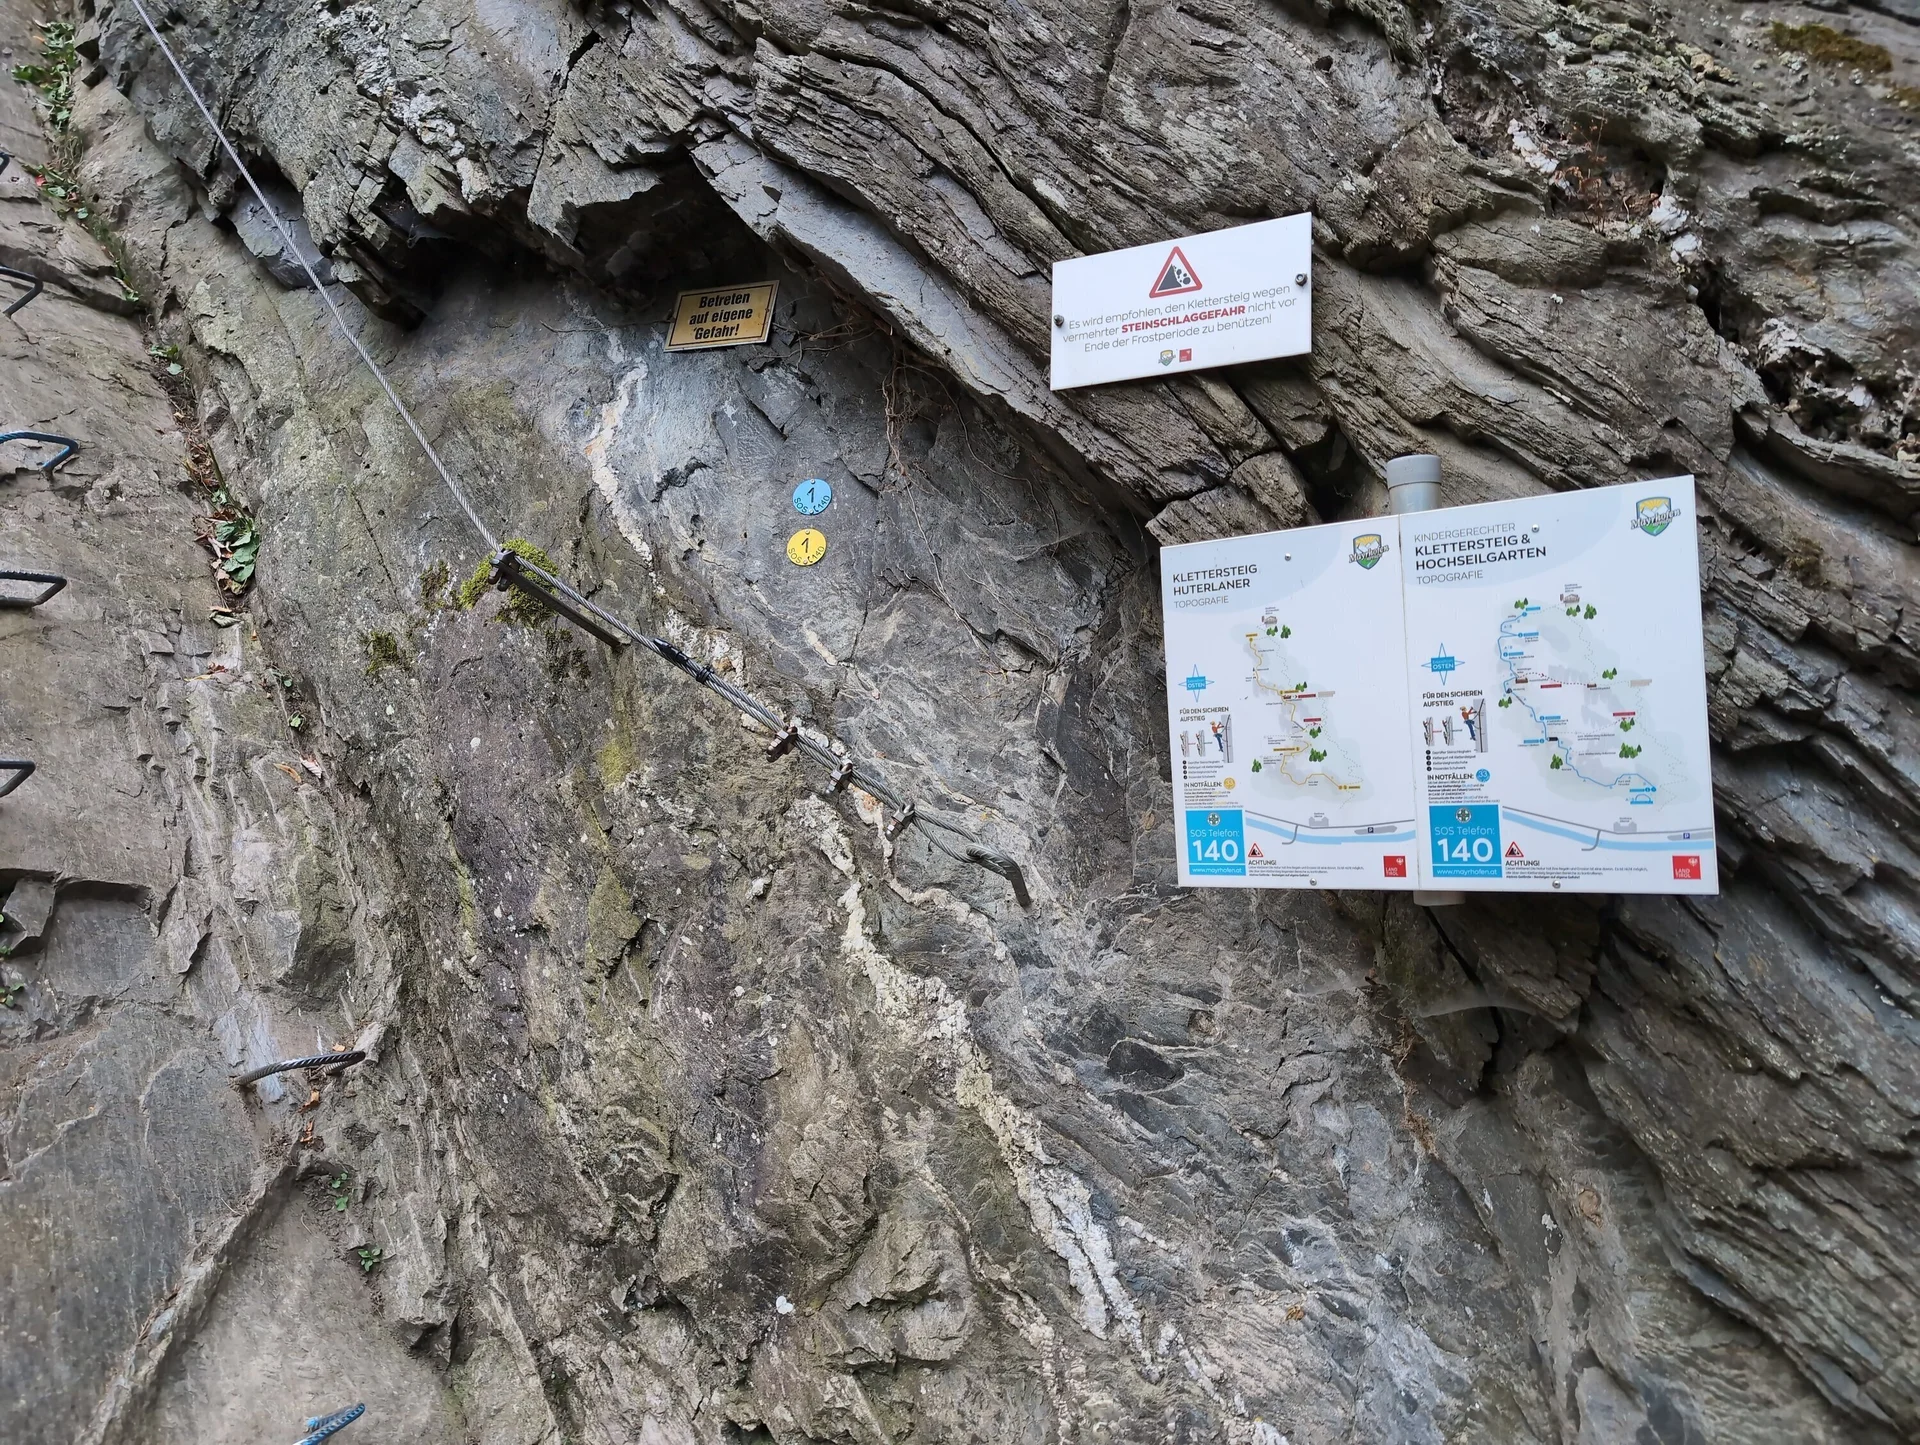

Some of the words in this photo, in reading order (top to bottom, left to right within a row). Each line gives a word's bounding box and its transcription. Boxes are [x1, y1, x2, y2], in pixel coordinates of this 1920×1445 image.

[699, 293, 750, 308] Betreten
[1069, 320, 1080, 329] Es
[1083, 316, 1103, 327] wird
[1105, 307, 1162, 324] empfohlen,
[1165, 302, 1185, 313] den
[1188, 291, 1250, 309] Klettersteig
[1253, 285, 1290, 298] wegen
[689, 315, 709, 325] auf
[712, 308, 753, 322] eigene
[1063, 326, 1119, 343] vermehrter
[1121, 305, 1246, 333] STEINSCHLAGGEFAHR
[1248, 301, 1276, 313] nicht
[1276, 298, 1297, 308] vor
[694, 324, 740, 340] Gefahr!
[1085, 342, 1110, 352] Ende
[1112, 337, 1129, 348] der
[1132, 326, 1200, 345] Frostperiode
[1202, 325, 1215, 334] zu
[1217, 314, 1272, 331] benützen!
[807, 487, 815, 503] 1
[794, 497, 808, 514] SOS
[818, 495, 830, 511] 140
[1630, 509, 1681, 530] Mayrhofen
[1414, 523, 1516, 543] KINDERGERECHTER
[801, 537, 809, 554] 1
[1349, 545, 1389, 563] Mayrhofen
[1415, 535, 1518, 556] KLETTERSTEIG
[1521, 534, 1531, 544] &
[788, 547, 802, 564] SOS
[812, 546, 825, 561] 140
[1416, 546, 1547, 570] HOCHSEILGARTEN
[1173, 564, 1258, 583] KLETTERSTEIG
[1416, 569, 1483, 585] TOPOGRAFIE
[1173, 578, 1250, 596] HUTERLANER
[1174, 595, 1229, 608] TOPOGRAFIE
[1202, 706, 1229, 714] SICHEREN
[1190, 829, 1207, 837] SOS
[1208, 829, 1240, 837] Telefon:
[1435, 826, 1454, 835] SOS
[1457, 826, 1495, 835] Telefon:
[1192, 839, 1239, 862] 140
[1437, 838, 1493, 862] 140
[1437, 868, 1497, 876] www.mayrhofen.at
